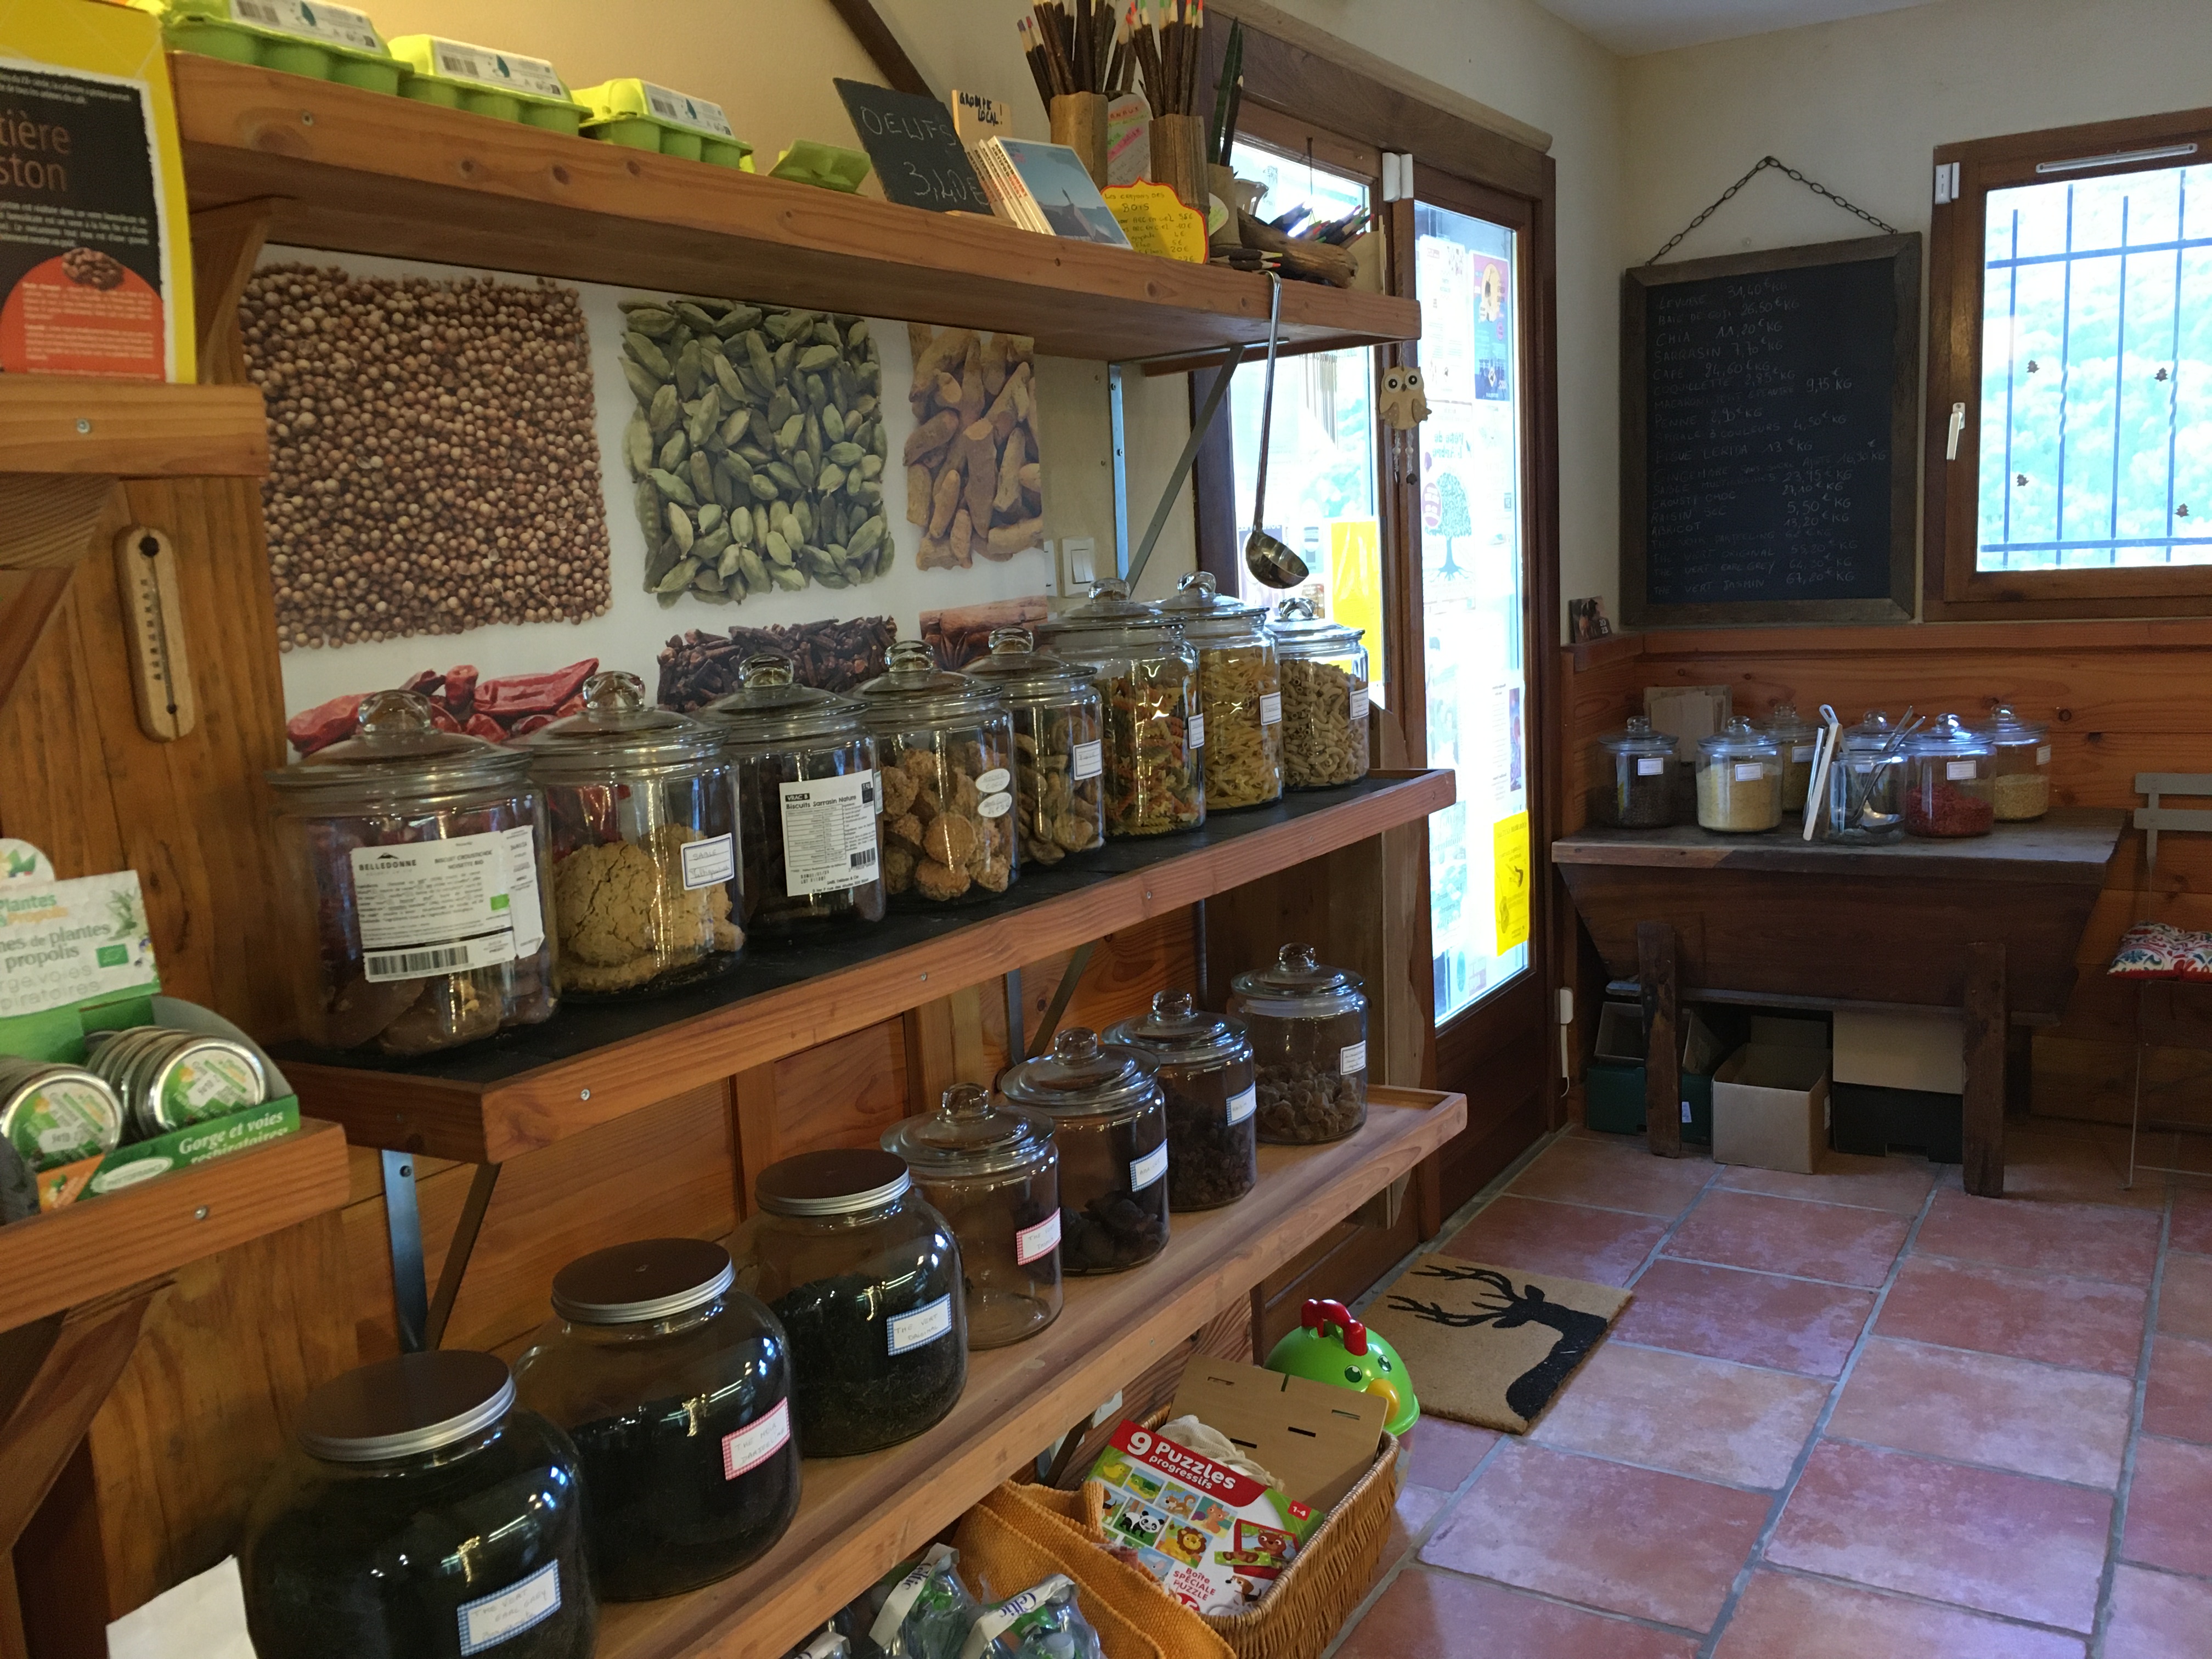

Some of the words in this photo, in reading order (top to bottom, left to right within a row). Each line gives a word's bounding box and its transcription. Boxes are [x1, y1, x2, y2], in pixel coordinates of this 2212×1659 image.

[1656, 331, 1690, 346] CHIA
[1767, 321, 1783, 332] KG
[1655, 347, 1721, 363] SARRASIN
[1768, 340, 1784, 351] KG
[1755, 361, 1770, 371] KG
[1780, 370, 1796, 380] KG
[1836, 377, 1852, 390] KG
[1655, 414, 1697, 428] PENNE
[1745, 408, 1763, 417] KG
[1709, 428, 1717, 438] 3
[1831, 415, 1847, 425] KG
[1797, 440, 1813, 452] KG
[1871, 450, 1886, 461] KG
[1836, 470, 1853, 481] KG
[1705, 491, 1736, 502] CHOC
[1826, 482, 1843, 491] KG
[1651, 509, 1692, 524] RAISIN
[1835, 497, 1851, 508] KG
[1651, 521, 1701, 538] ABRICOT
[1832, 513, 1849, 523] KG
[1836, 571, 1854, 582] KG
[786, 802, 810, 810] Biscuits
[812, 799, 837, 807] Sarrasin
[839, 795, 856, 803] Nature
[359, 859, 416, 871] BELLEDONNE
[30, 935, 46, 946] de
[49, 923, 111, 948] plantes
[5, 944, 80, 974] propolis
[37, 964, 92, 984] voies
[179, 1132, 225, 1156] Gorge
[229, 1125, 244, 1140] et
[247, 1111, 284, 1133] voies
[921, 1313, 938, 1326] VERT
[907, 1325, 939, 1341] ORIGINAL
[1126, 1431, 1152, 1457] 9
[1155, 1441, 1237, 1490] Puzzles
[1149, 1454, 1213, 1491] progressifs
[901, 1562, 933, 1590] Celtic
[1172, 1568, 1217, 1597] SPÉCIALE
[1185, 1566, 1211, 1585] Boîte
[1172, 1579, 1209, 1601] PUZZLE
[998, 1592, 1036, 1618] Celtic
